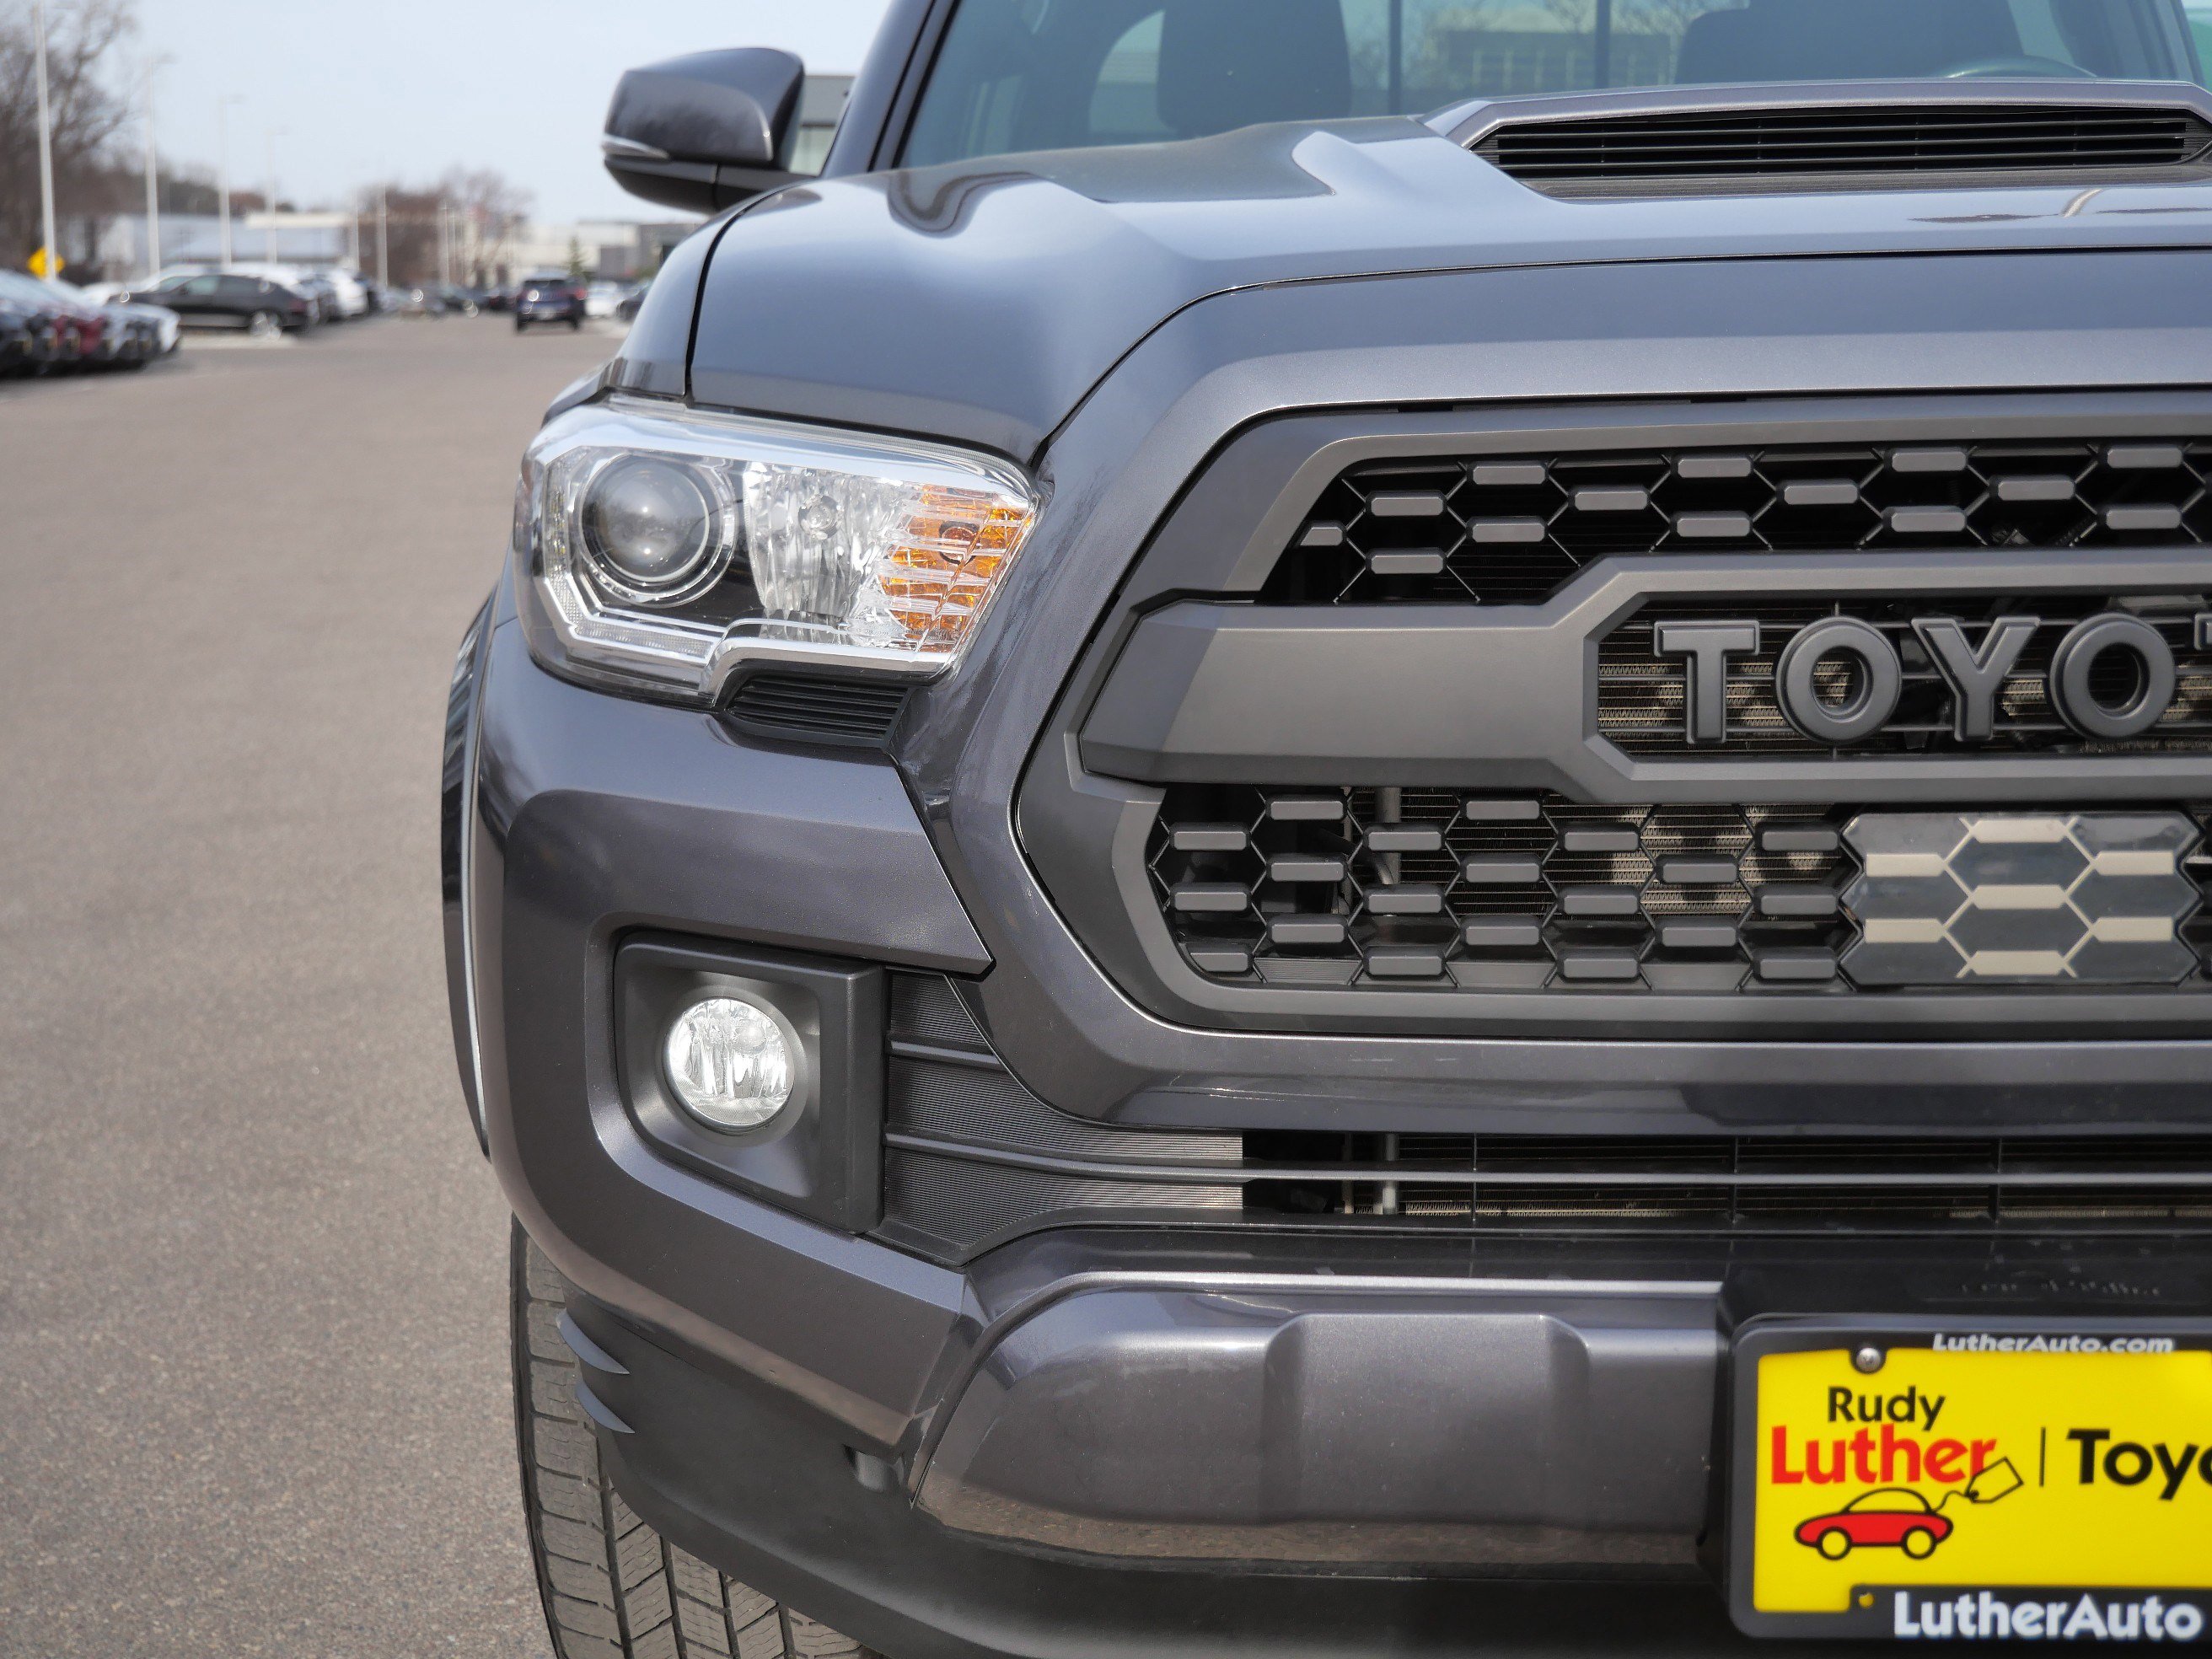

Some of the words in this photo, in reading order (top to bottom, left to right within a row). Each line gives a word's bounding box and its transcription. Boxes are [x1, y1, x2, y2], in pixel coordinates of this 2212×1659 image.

[1653, 614, 2212, 744] TOYO
[1933, 1333, 2174, 1353] LutherAuto.com
[1828, 1385, 1946, 1431] Rudy
[1771, 1423, 1997, 1485] Luther
[2065, 1428, 2212, 1501] Toy
[1894, 1591, 2203, 1640] LutherAuto
